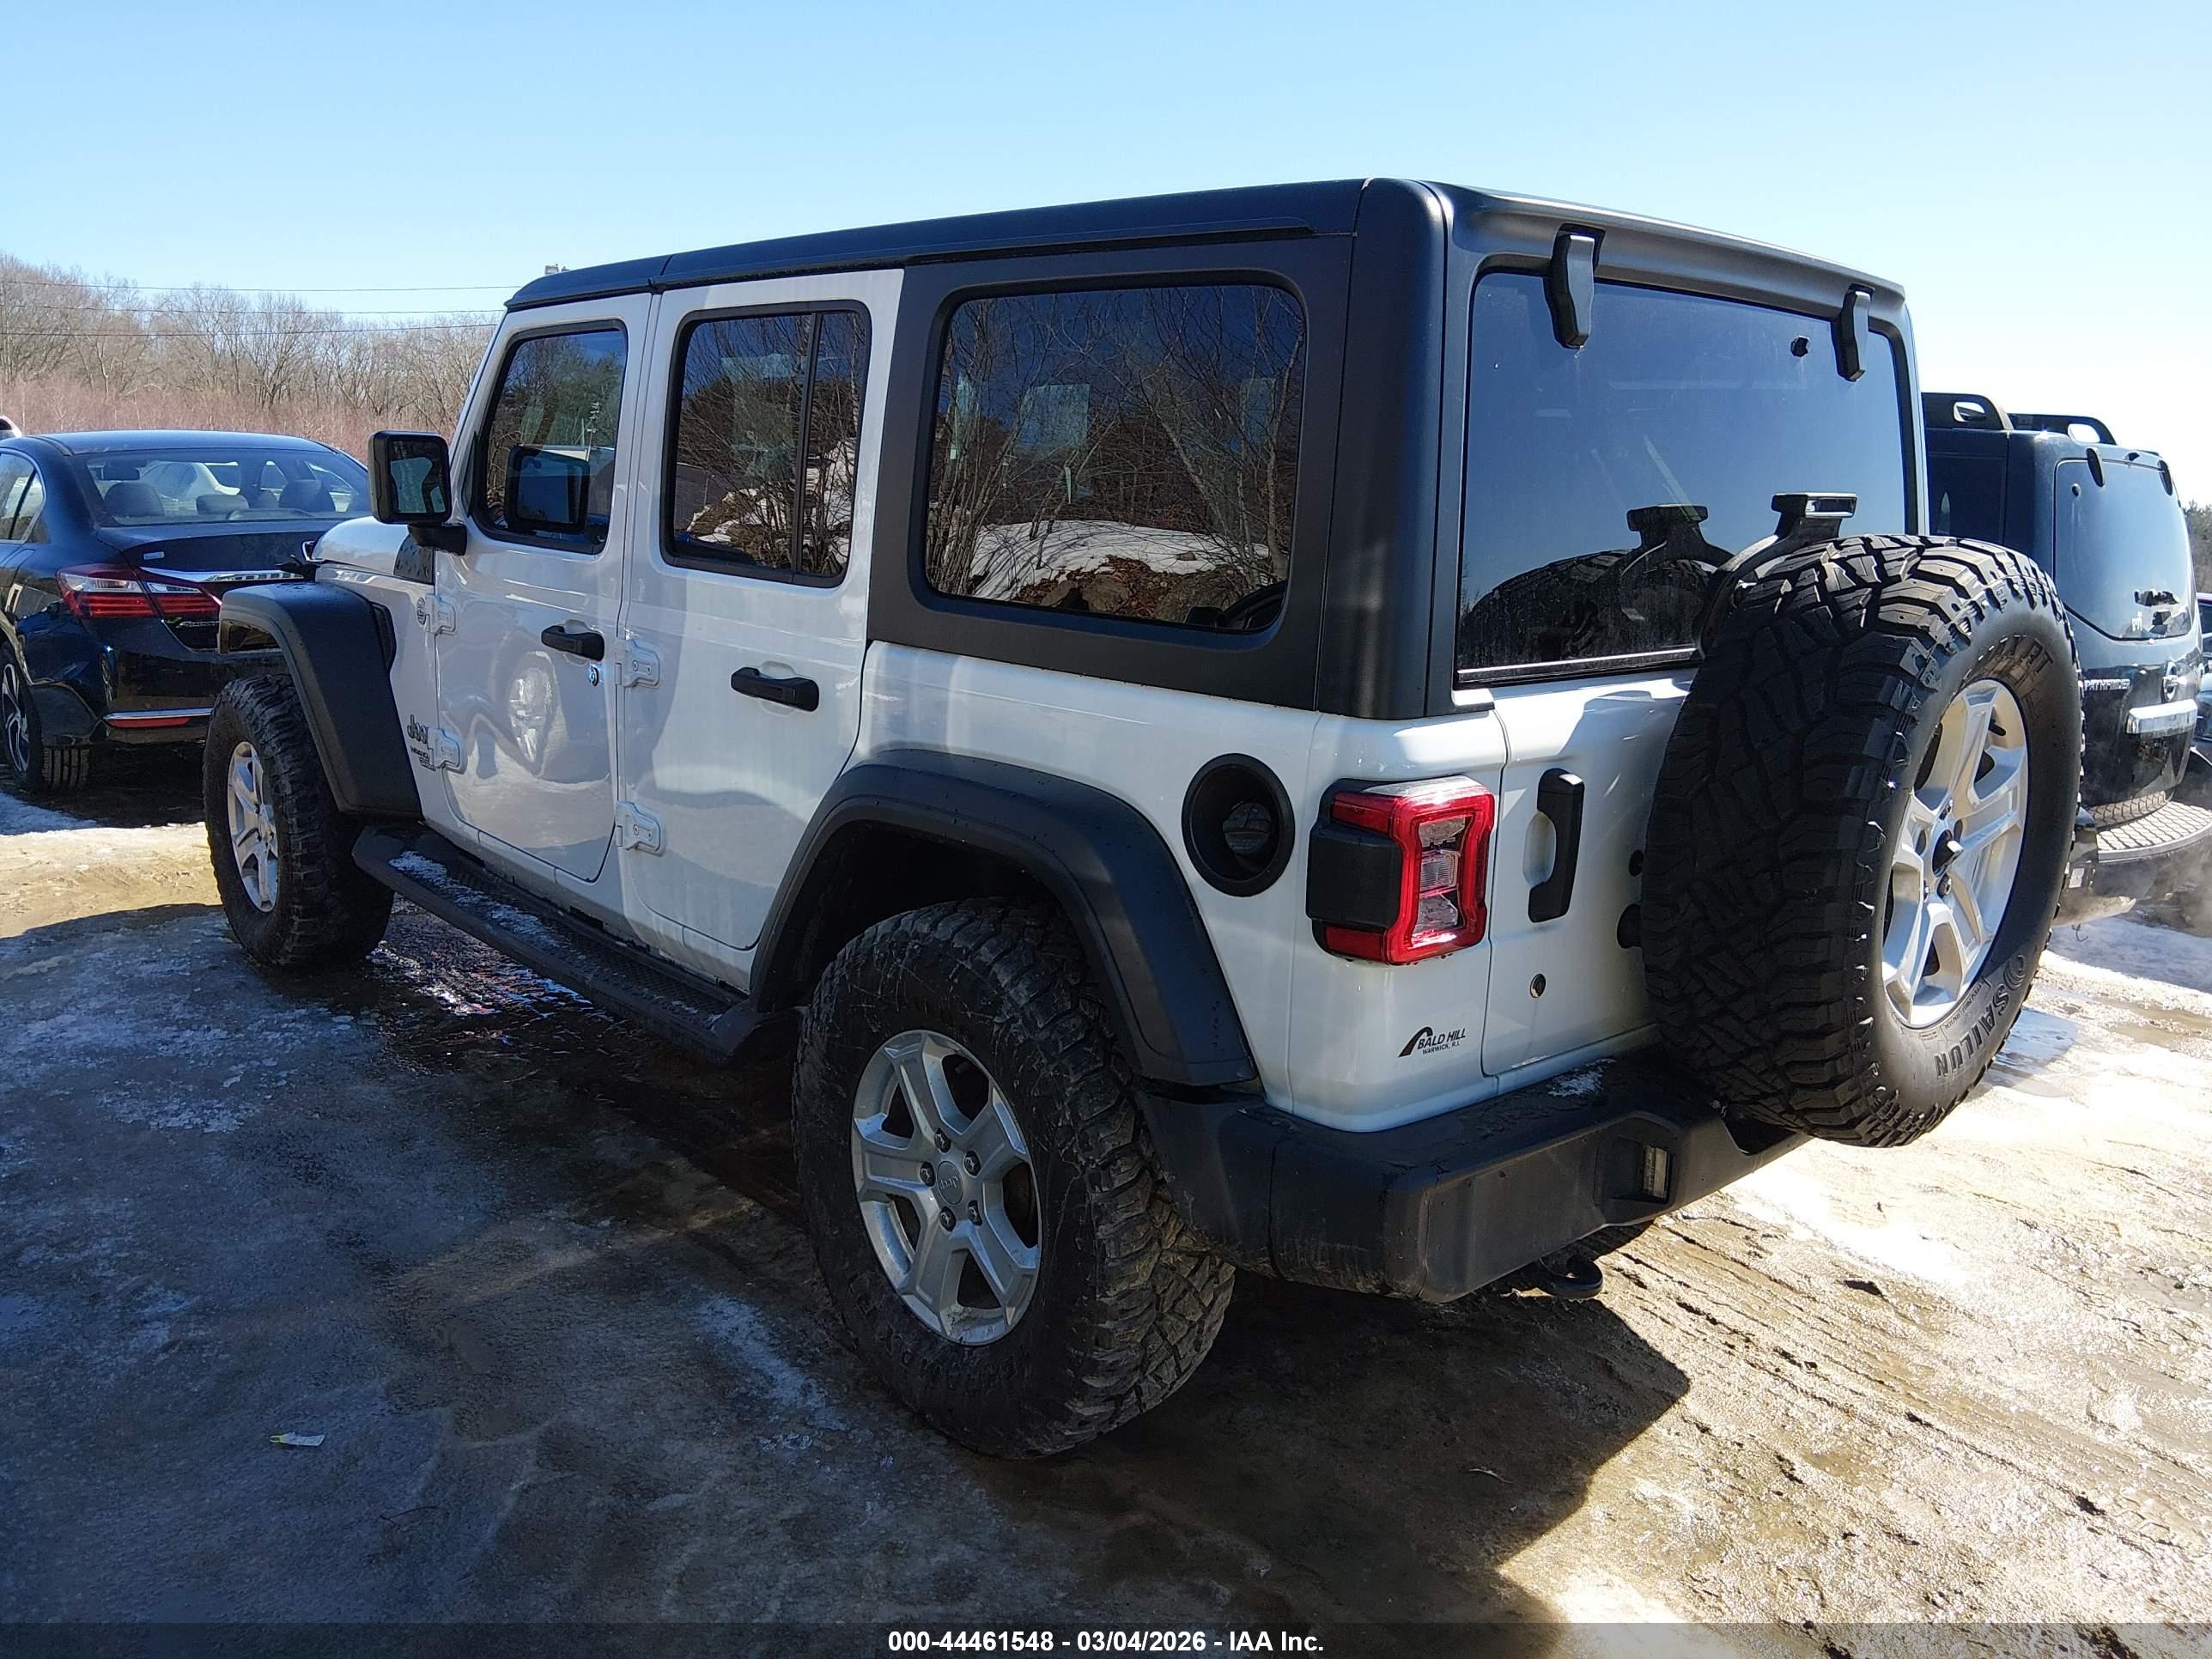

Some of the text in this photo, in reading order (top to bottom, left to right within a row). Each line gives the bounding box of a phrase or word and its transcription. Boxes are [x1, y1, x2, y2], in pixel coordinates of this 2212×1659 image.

[1417, 1028, 1466, 1050] BALD HILL
[1934, 983, 2009, 1080] SAILUN
